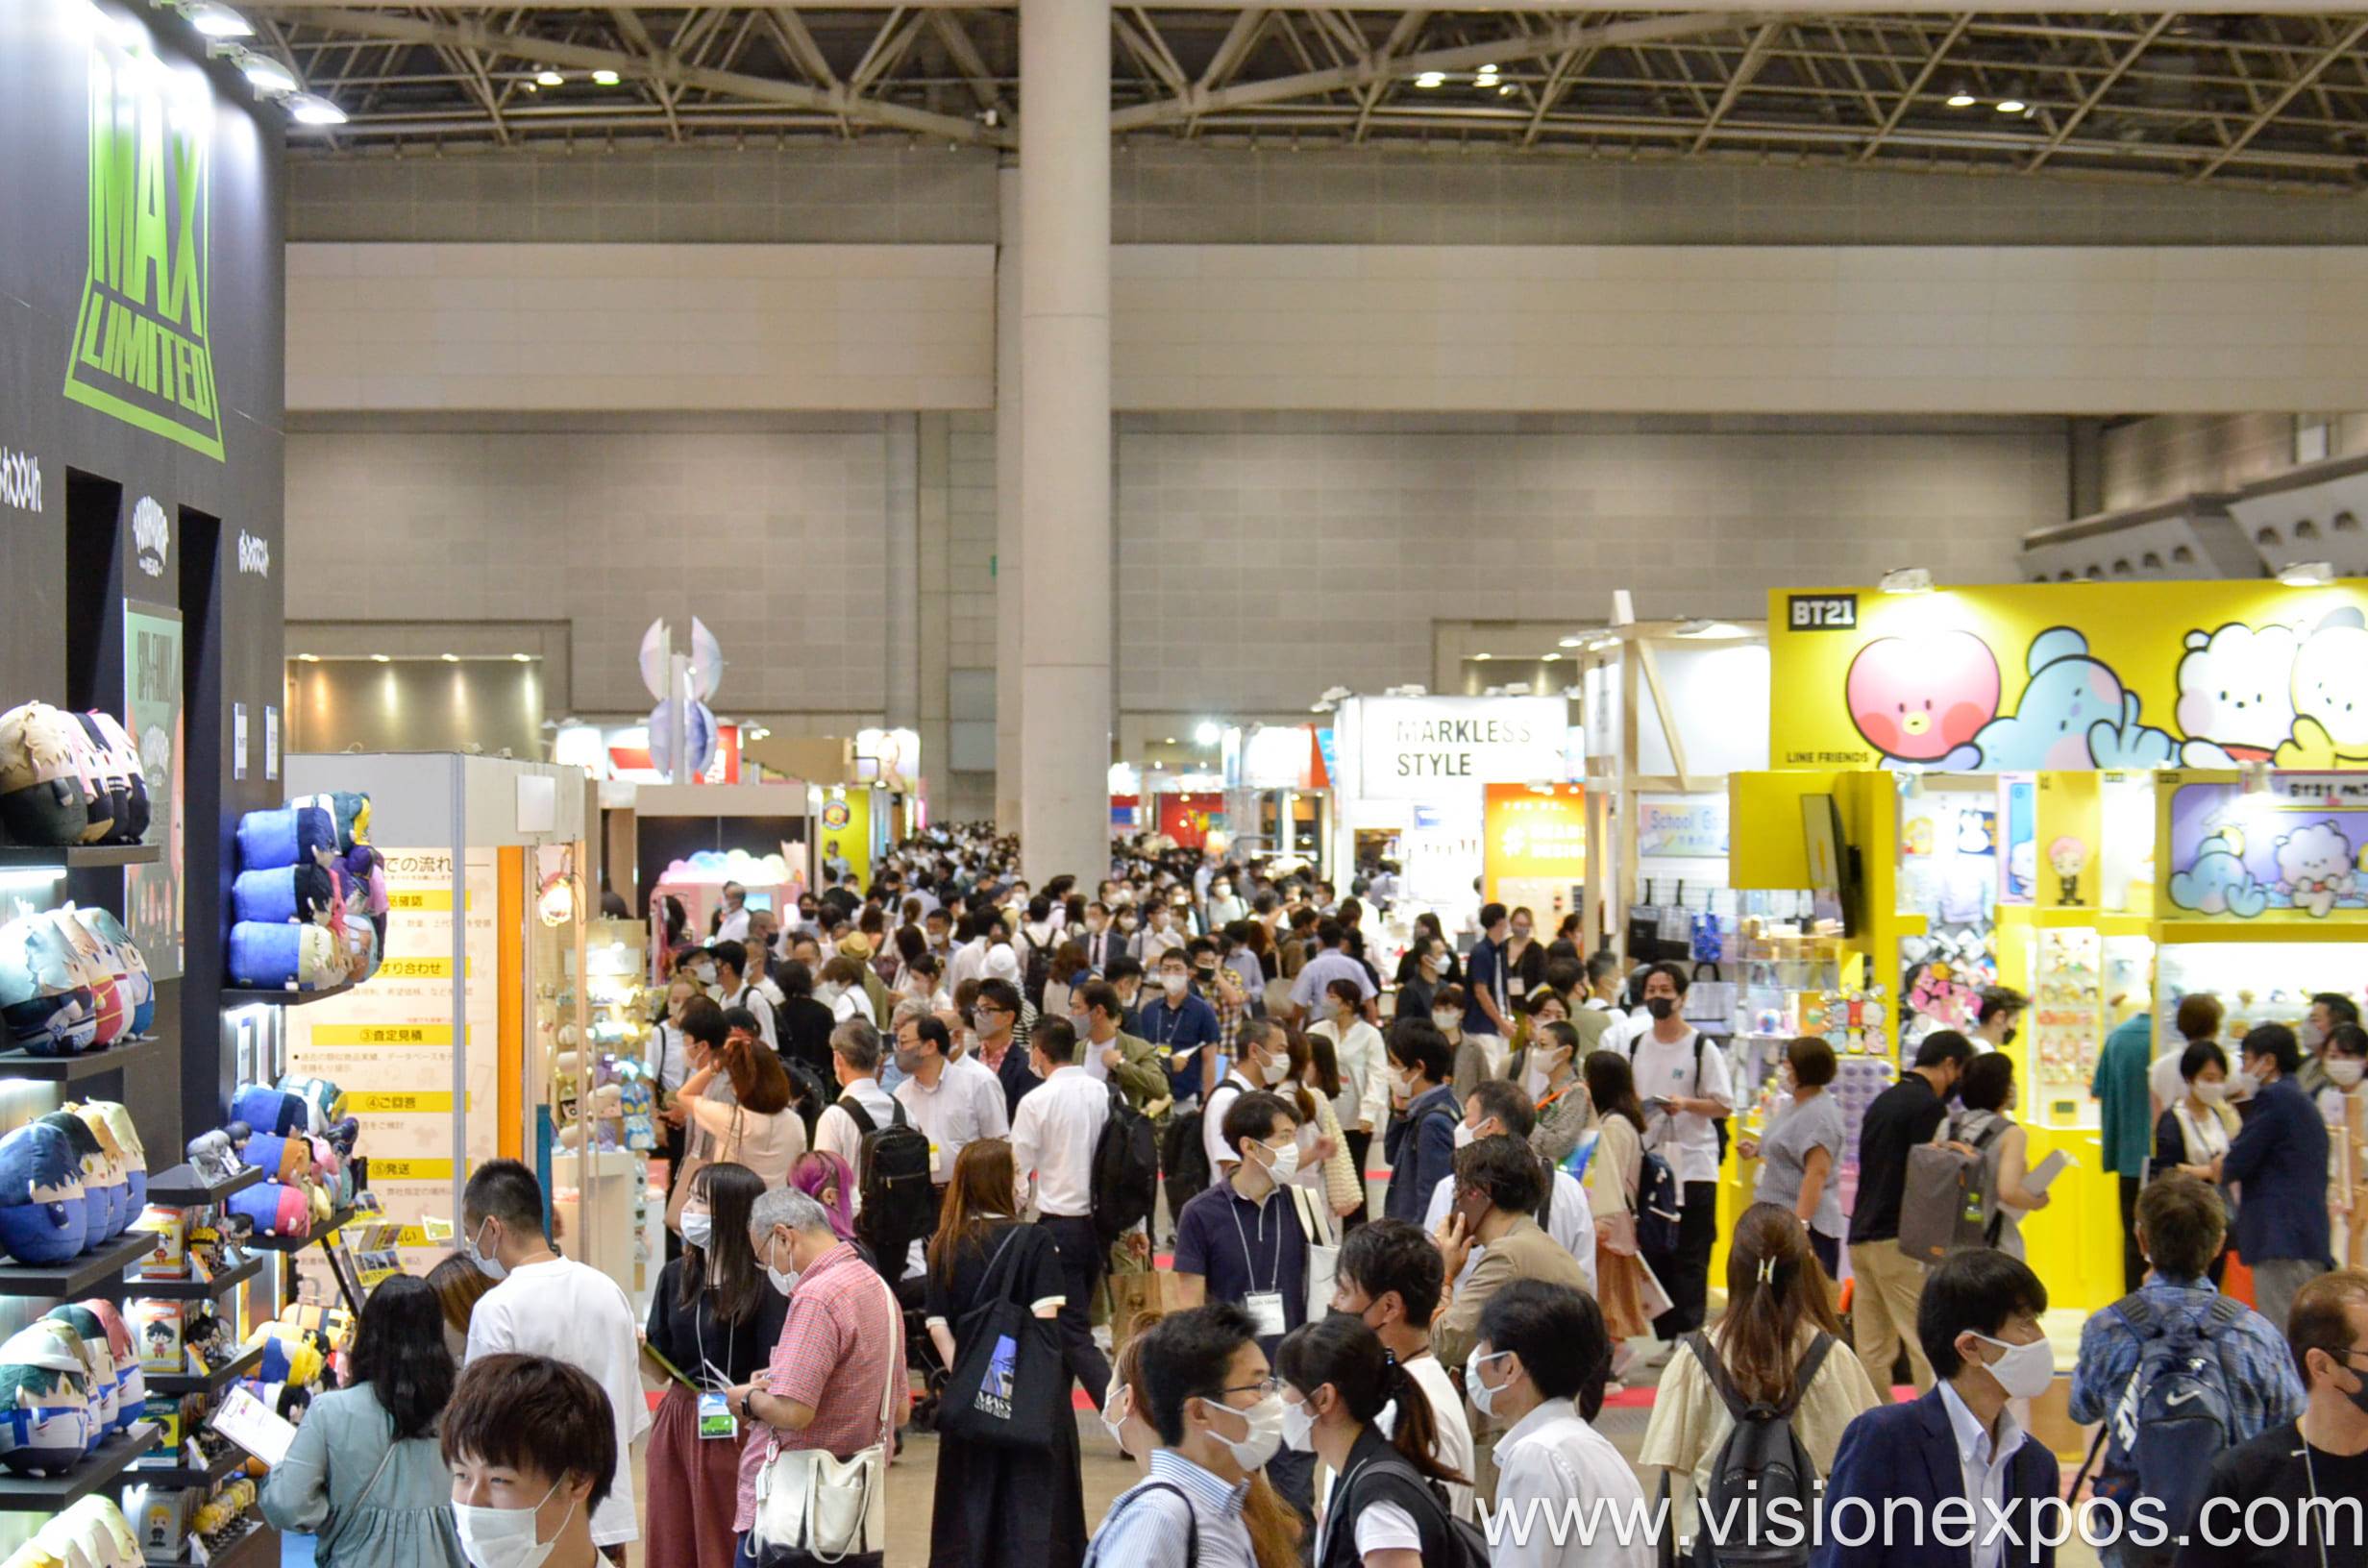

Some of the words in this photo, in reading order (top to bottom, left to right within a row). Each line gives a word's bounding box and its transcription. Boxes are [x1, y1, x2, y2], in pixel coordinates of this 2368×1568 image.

[93, 46, 204, 338] MAX
[80, 291, 212, 420] LIMITED
[1792, 600, 1854, 625] BT21
[1397, 720, 1530, 743] MARKLESS
[1397, 753, 1470, 776] STYLE
[1787, 750, 1813, 763] LINE
[1817, 750, 1869, 763] FRIENDS
